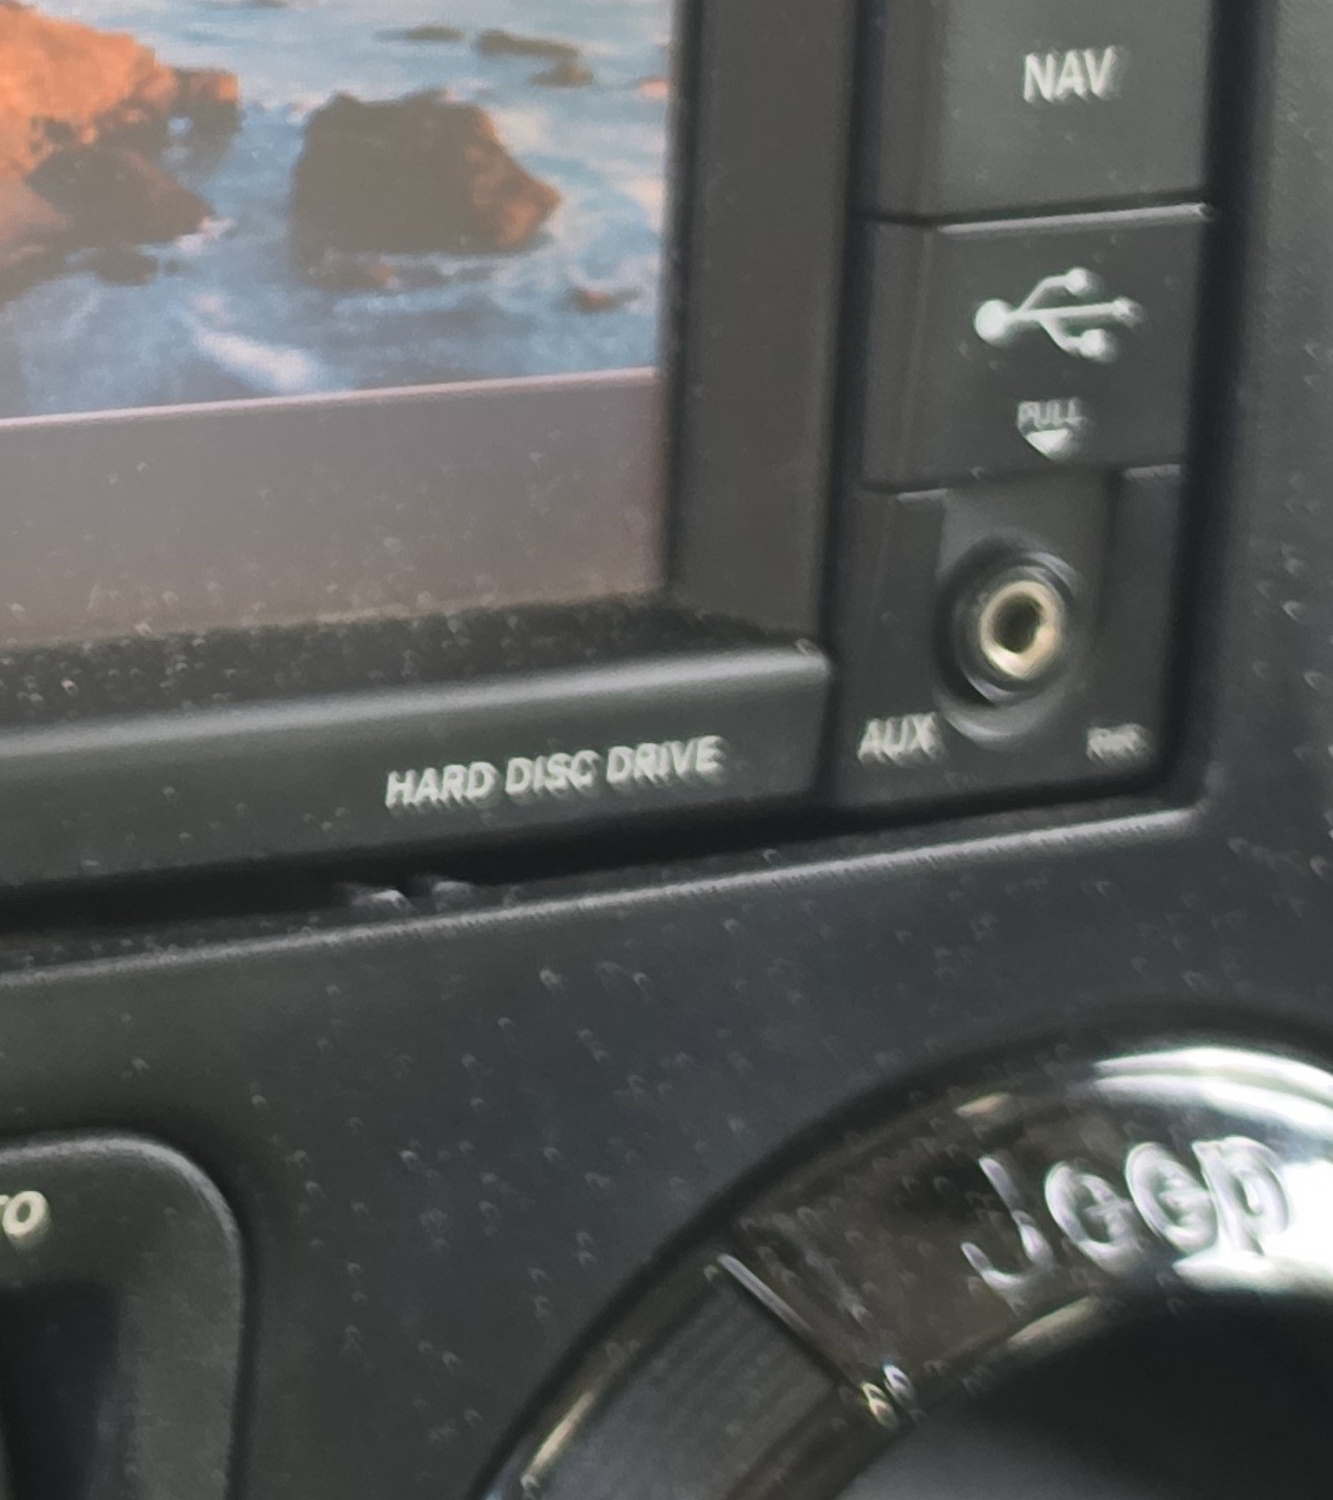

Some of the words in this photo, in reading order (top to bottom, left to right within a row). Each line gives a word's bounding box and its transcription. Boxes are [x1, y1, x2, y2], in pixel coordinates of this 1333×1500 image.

[1022, 45, 1121, 103] NAV
[1016, 398, 1083, 430] PULL
[858, 712, 937, 765] AUX
[384, 758, 497, 810] HARD
[503, 746, 597, 796] DISC
[604, 732, 727, 786] DRIVE
[959, 1132, 1293, 1298] Jeep
